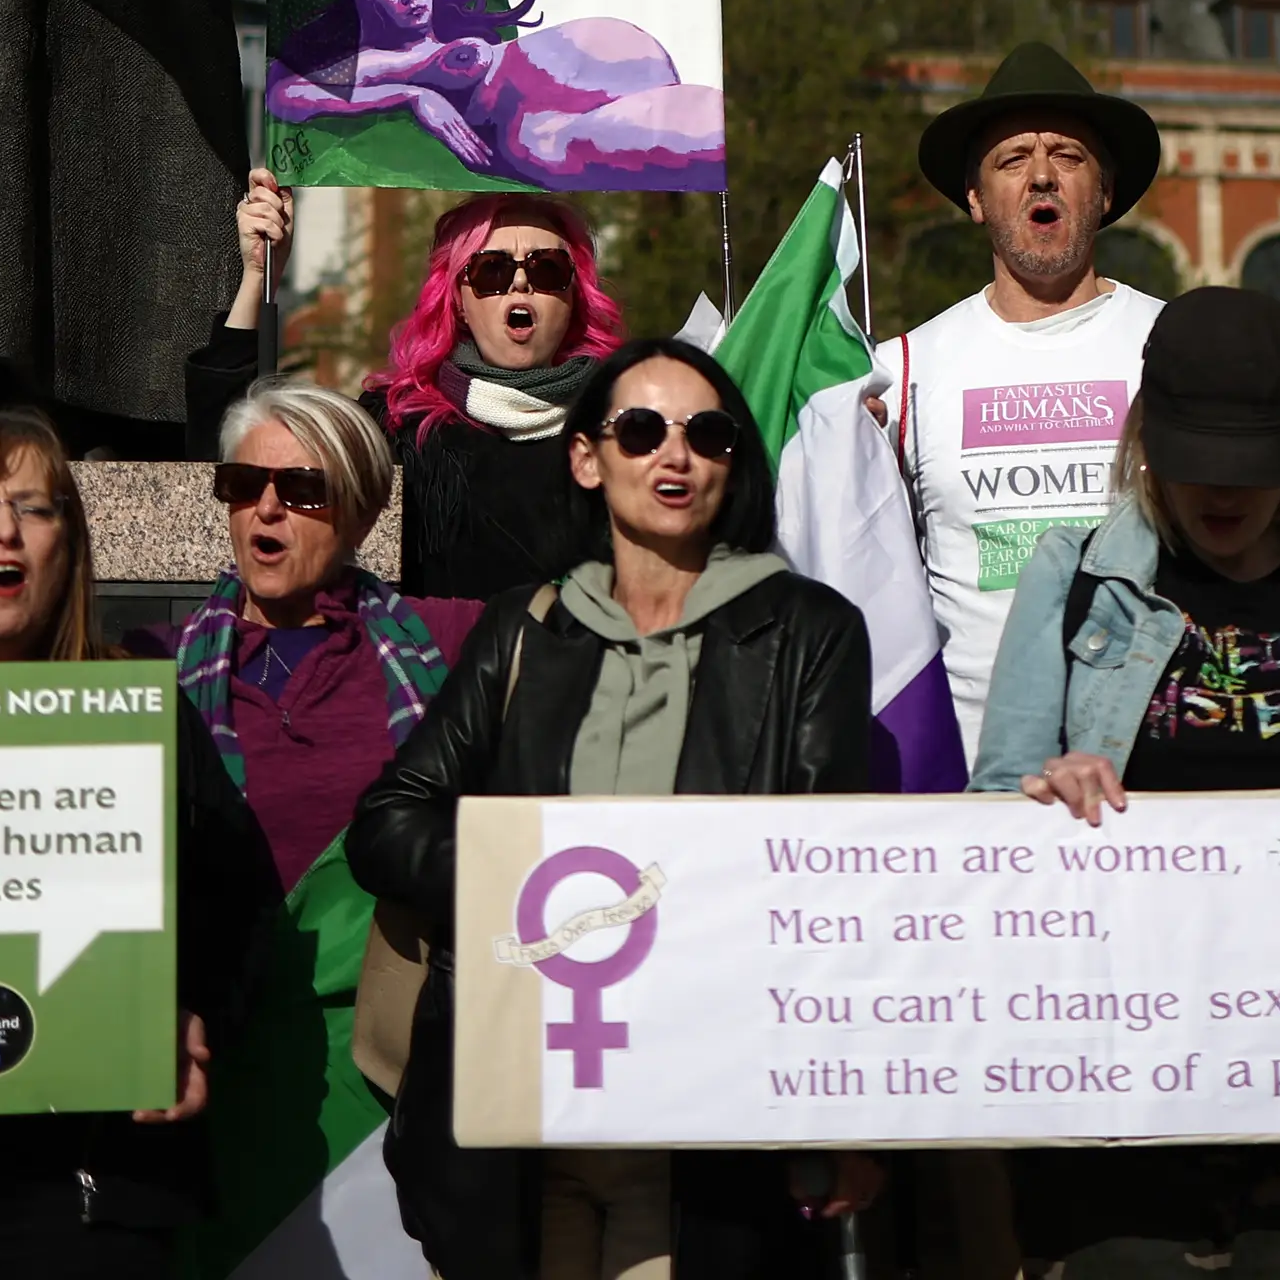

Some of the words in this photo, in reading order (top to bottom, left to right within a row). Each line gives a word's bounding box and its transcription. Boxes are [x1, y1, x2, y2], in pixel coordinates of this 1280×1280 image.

[993, 382, 1094, 401] FANTASTIC
[980, 395, 1115, 423] HUMANS
[980, 424, 1002, 434] AND
[1003, 422, 1036, 432] WHAT
[1040, 421, 1054, 430] TO
[961, 462, 1116, 502] WOME
[976, 523, 1016, 538] FEAR
[1020, 520, 1042, 533] OF
[979, 535, 1014, 552] ONLY
[980, 549, 1014, 565] FEAR
[980, 560, 1023, 578] ITSELF
[9, 688, 77, 715] NOT
[82, 687, 163, 714] HATE
[54, 786, 117, 810] are
[3, 827, 142, 856] human
[765, 837, 939, 875] Women
[961, 843, 1035, 874] are
[1057, 842, 1244, 878] women,
[768, 909, 865, 945] Men
[892, 910, 966, 942] are
[992, 906, 1112, 943] men,
[768, 987, 853, 1024] You
[1007, 985, 1180, 1032] change
[769, 1059, 865, 1097] with
[886, 1059, 958, 1095] the
[984, 1056, 1133, 1094] stroke
[1151, 1052, 1201, 1093] of
[1226, 1060, 1253, 1090] a
